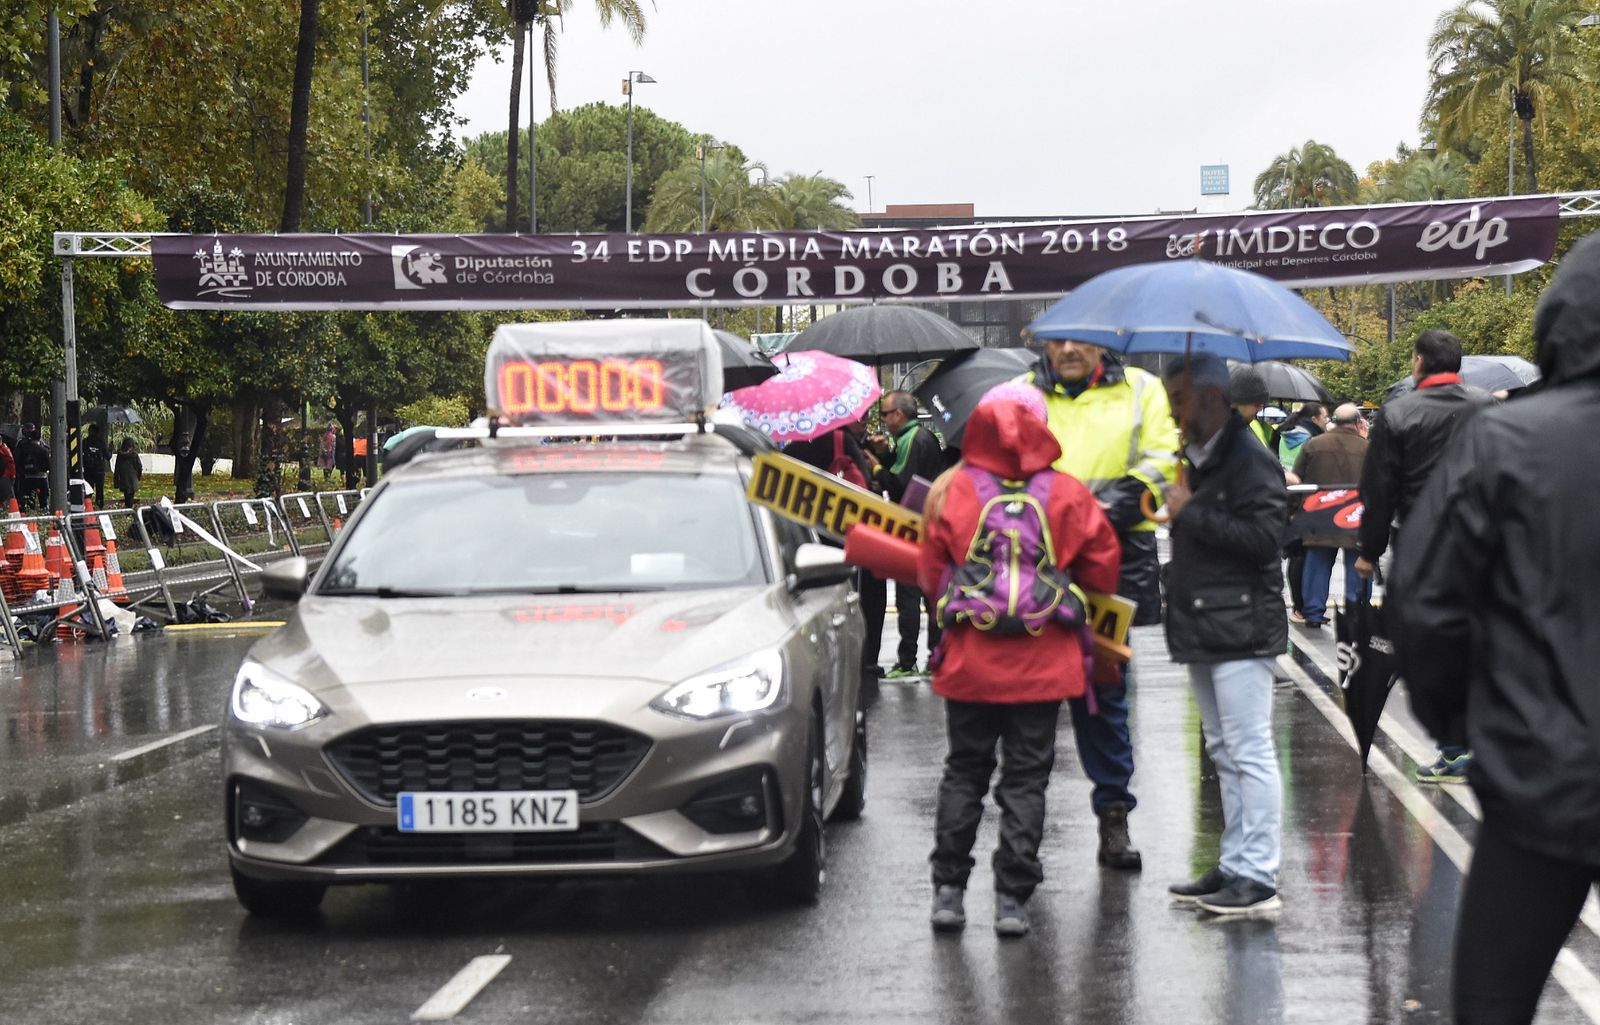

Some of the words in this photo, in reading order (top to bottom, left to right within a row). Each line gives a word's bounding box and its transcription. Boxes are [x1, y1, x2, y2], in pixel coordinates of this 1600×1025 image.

[570, 239, 612, 263] 34
[627, 239, 693, 263] EDP
[707, 237, 825, 263] MEDIA
[840, 228, 1026, 261] MARATÓN
[1041, 226, 1129, 255] 2018
[1215, 220, 1382, 257] IMDECO
[1416, 204, 1509, 261] edp
[254, 250, 363, 267] AYUNTAMIENTO
[455, 256, 552, 272] Diputación
[1265, 258, 1279, 267] de
[1281, 255, 1330, 267] Deportes
[255, 271, 274, 286] DE
[277, 267, 348, 286] CÓRDOBA
[456, 271, 478, 284] de
[482, 271, 555, 284] Córdoba
[686, 261, 1014, 298] CÓRDOBA
[425, 797, 498, 826] 1185
[510, 796, 568, 825] KNZ
